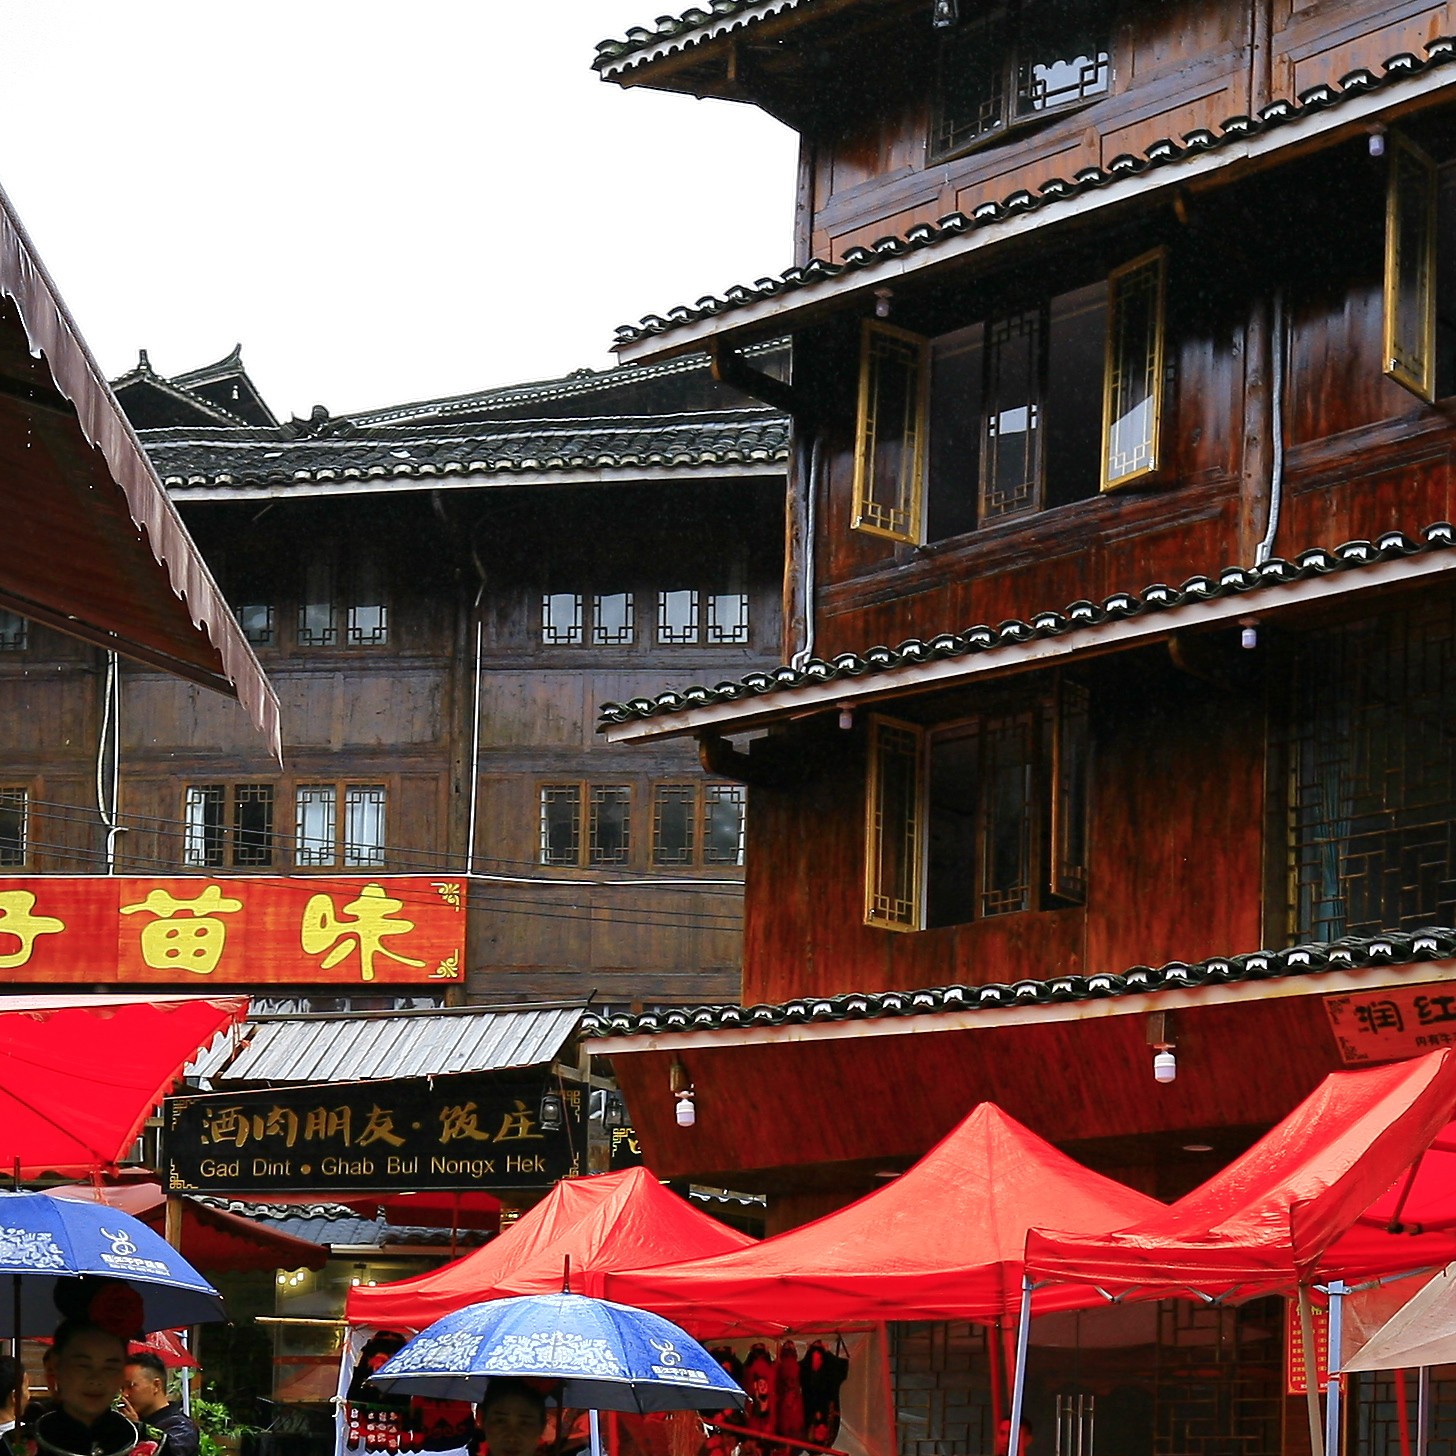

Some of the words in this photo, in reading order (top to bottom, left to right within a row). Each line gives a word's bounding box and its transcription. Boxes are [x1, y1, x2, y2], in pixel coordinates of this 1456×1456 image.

[200, 1160, 239, 1178] Gad
[252, 1159, 291, 1176] Dint
[321, 1156, 374, 1176] Ghab
[387, 1156, 418, 1174] Bul
[430, 1157, 494, 1178] Nongx
[506, 1156, 545, 1173] Hek
